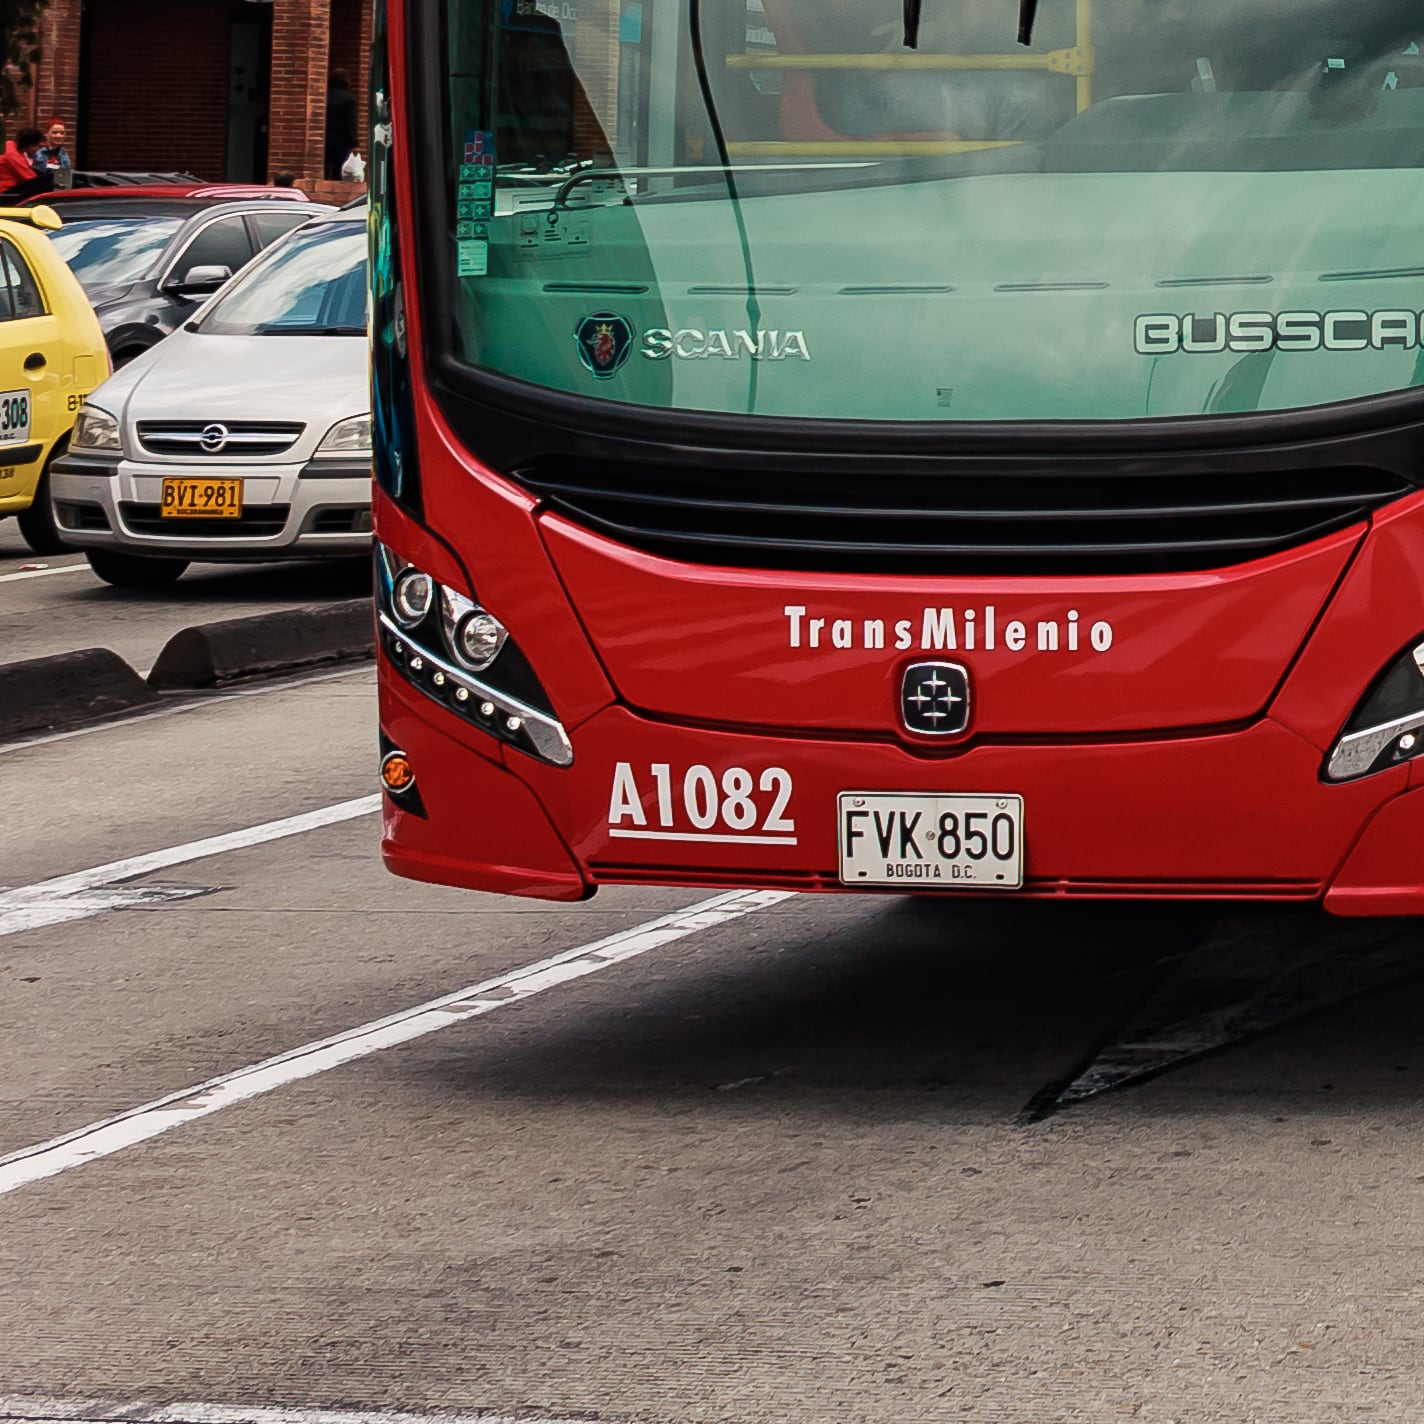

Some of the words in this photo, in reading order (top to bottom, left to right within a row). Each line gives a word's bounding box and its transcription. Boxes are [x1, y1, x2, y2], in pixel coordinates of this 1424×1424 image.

[640, 328, 812, 362] SCANIA
[784, 605, 1114, 652] TransMilenio
[608, 761, 796, 832] A1082
[886, 863, 942, 878] BOGOTA
[951, 864, 977, 880] D.C.
